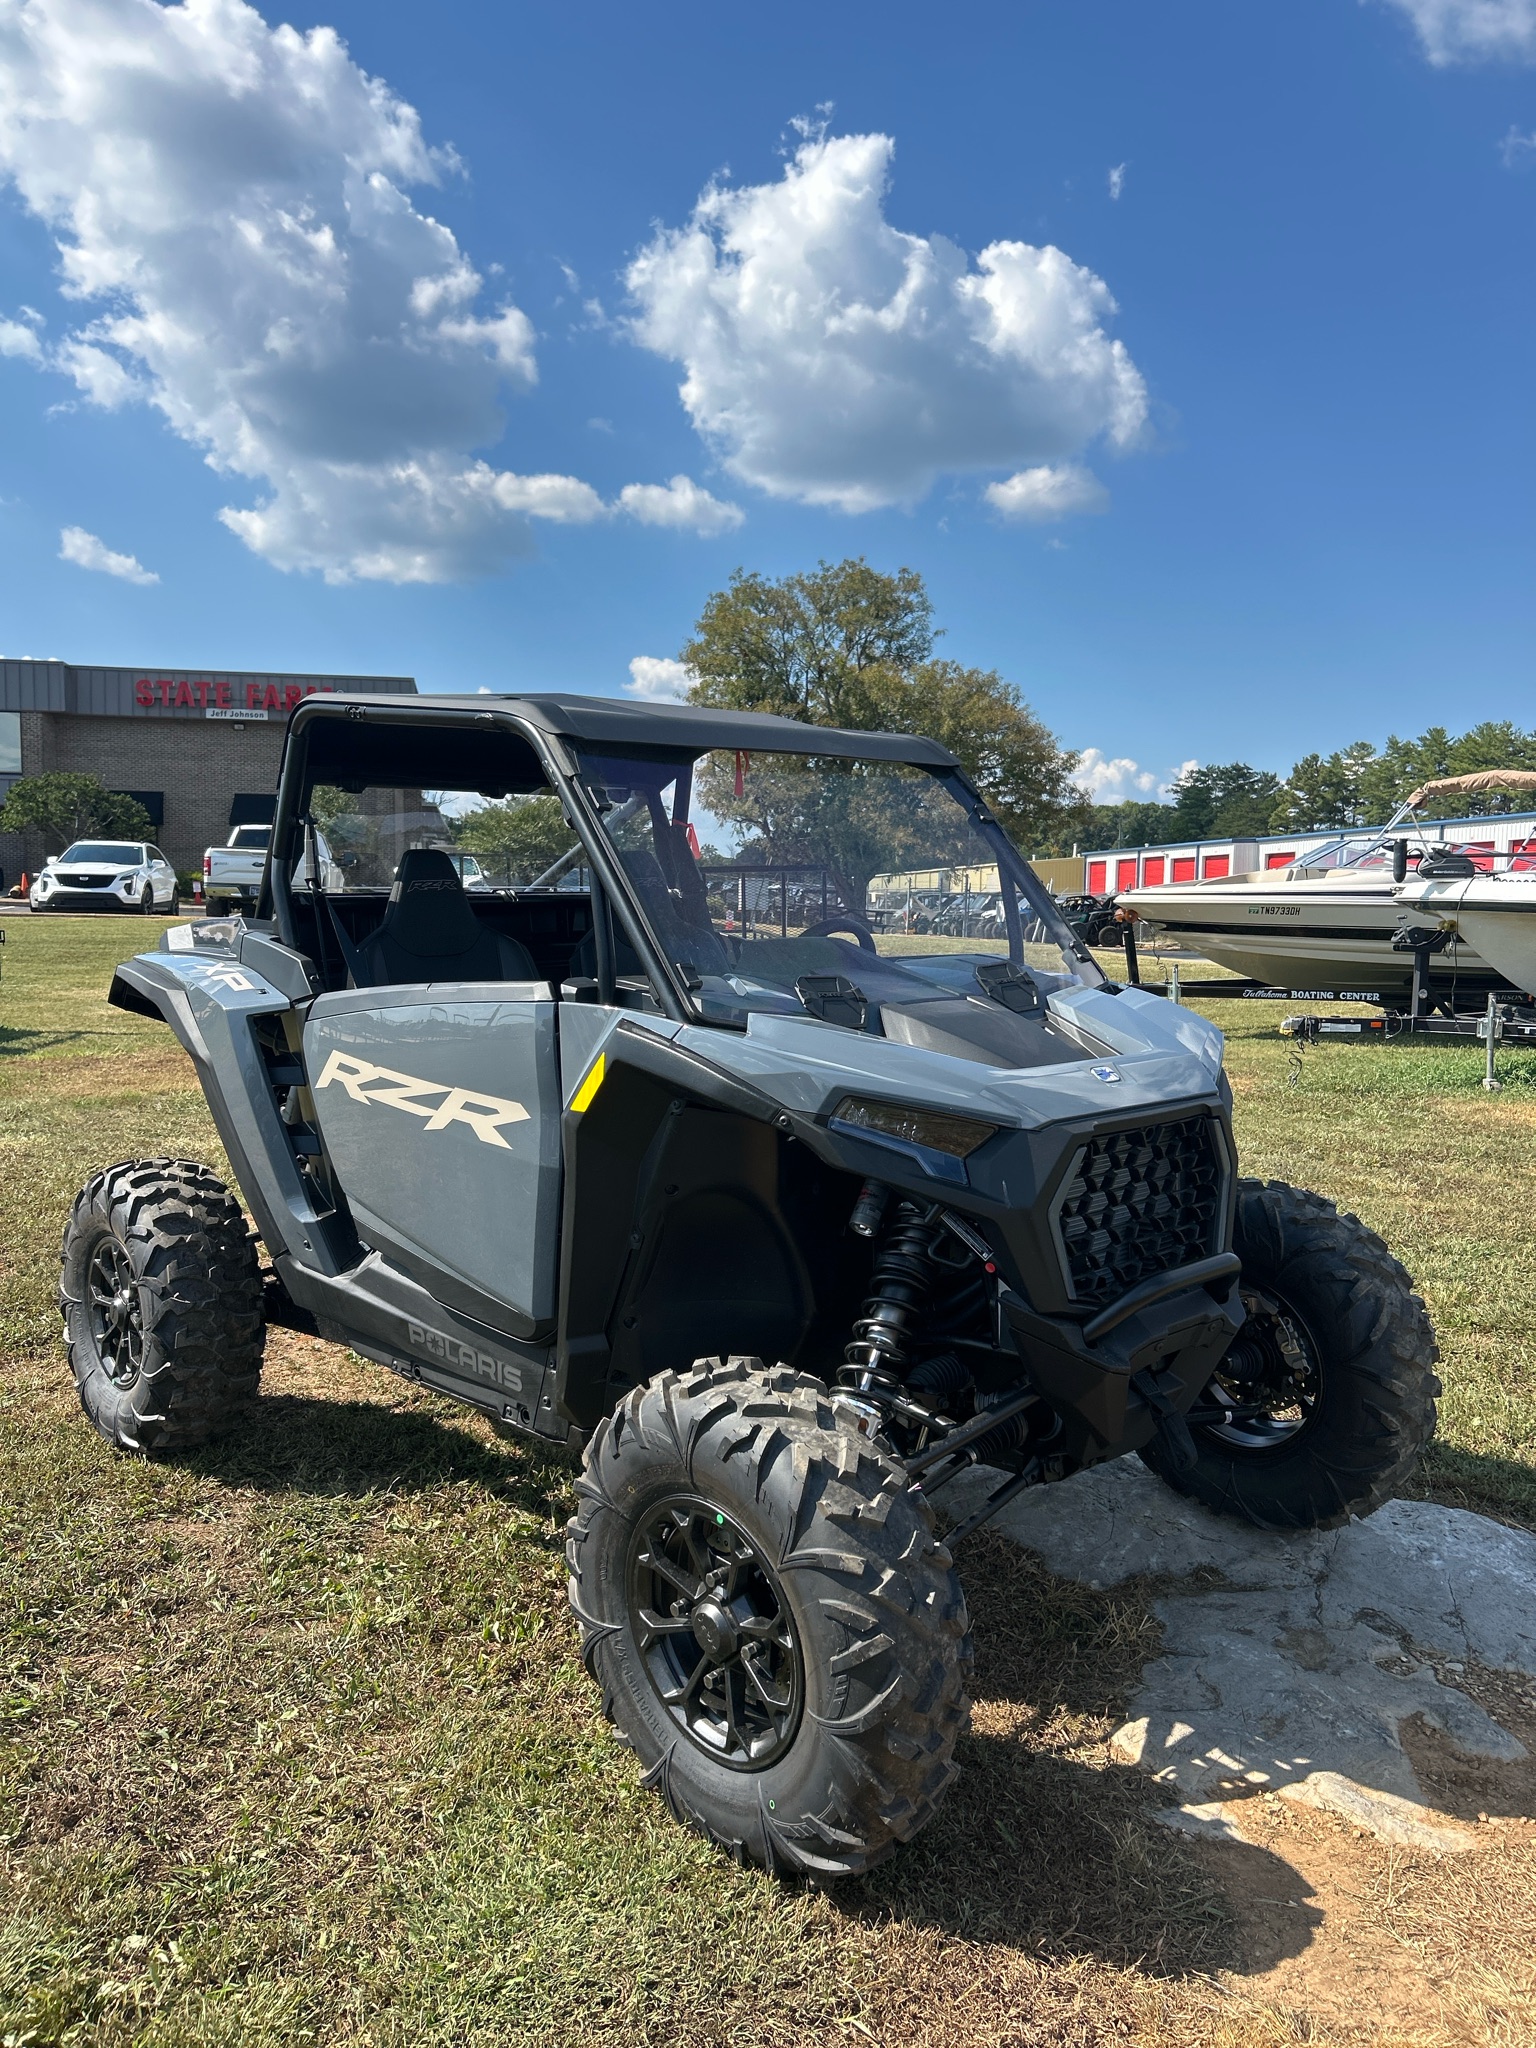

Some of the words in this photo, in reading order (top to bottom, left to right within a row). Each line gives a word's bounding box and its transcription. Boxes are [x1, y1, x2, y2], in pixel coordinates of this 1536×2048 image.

[135, 679, 232, 708] STATE
[230, 710, 264, 719] Johnson
[407, 880, 458, 893] RZR
[205, 962, 255, 991] XP
[1242, 989, 1289, 998] Tullahoma
[1290, 990, 1334, 999] BOATING
[1339, 992, 1380, 1001] CENTER
[315, 1049, 531, 1149] RZR
[408, 1323, 523, 1392] POLARIS
